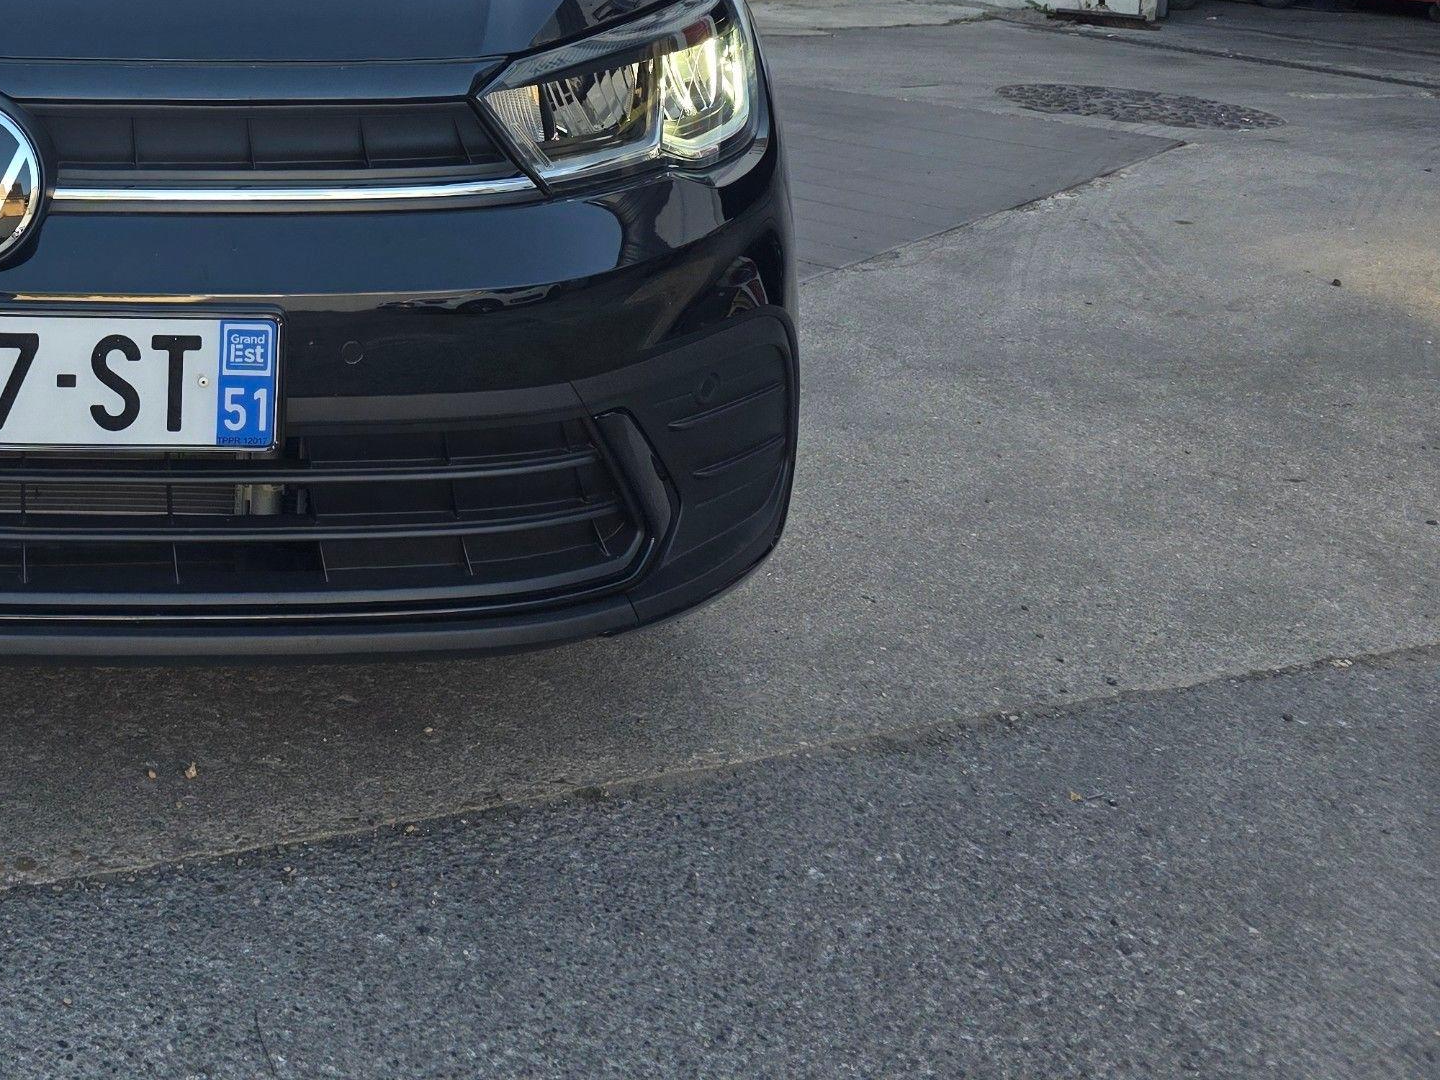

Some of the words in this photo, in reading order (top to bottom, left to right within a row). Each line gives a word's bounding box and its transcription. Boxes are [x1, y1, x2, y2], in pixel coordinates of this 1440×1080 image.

[230, 333, 266, 344] Grand
[229, 344, 264, 363] Est
[224, 387, 268, 432] 51
